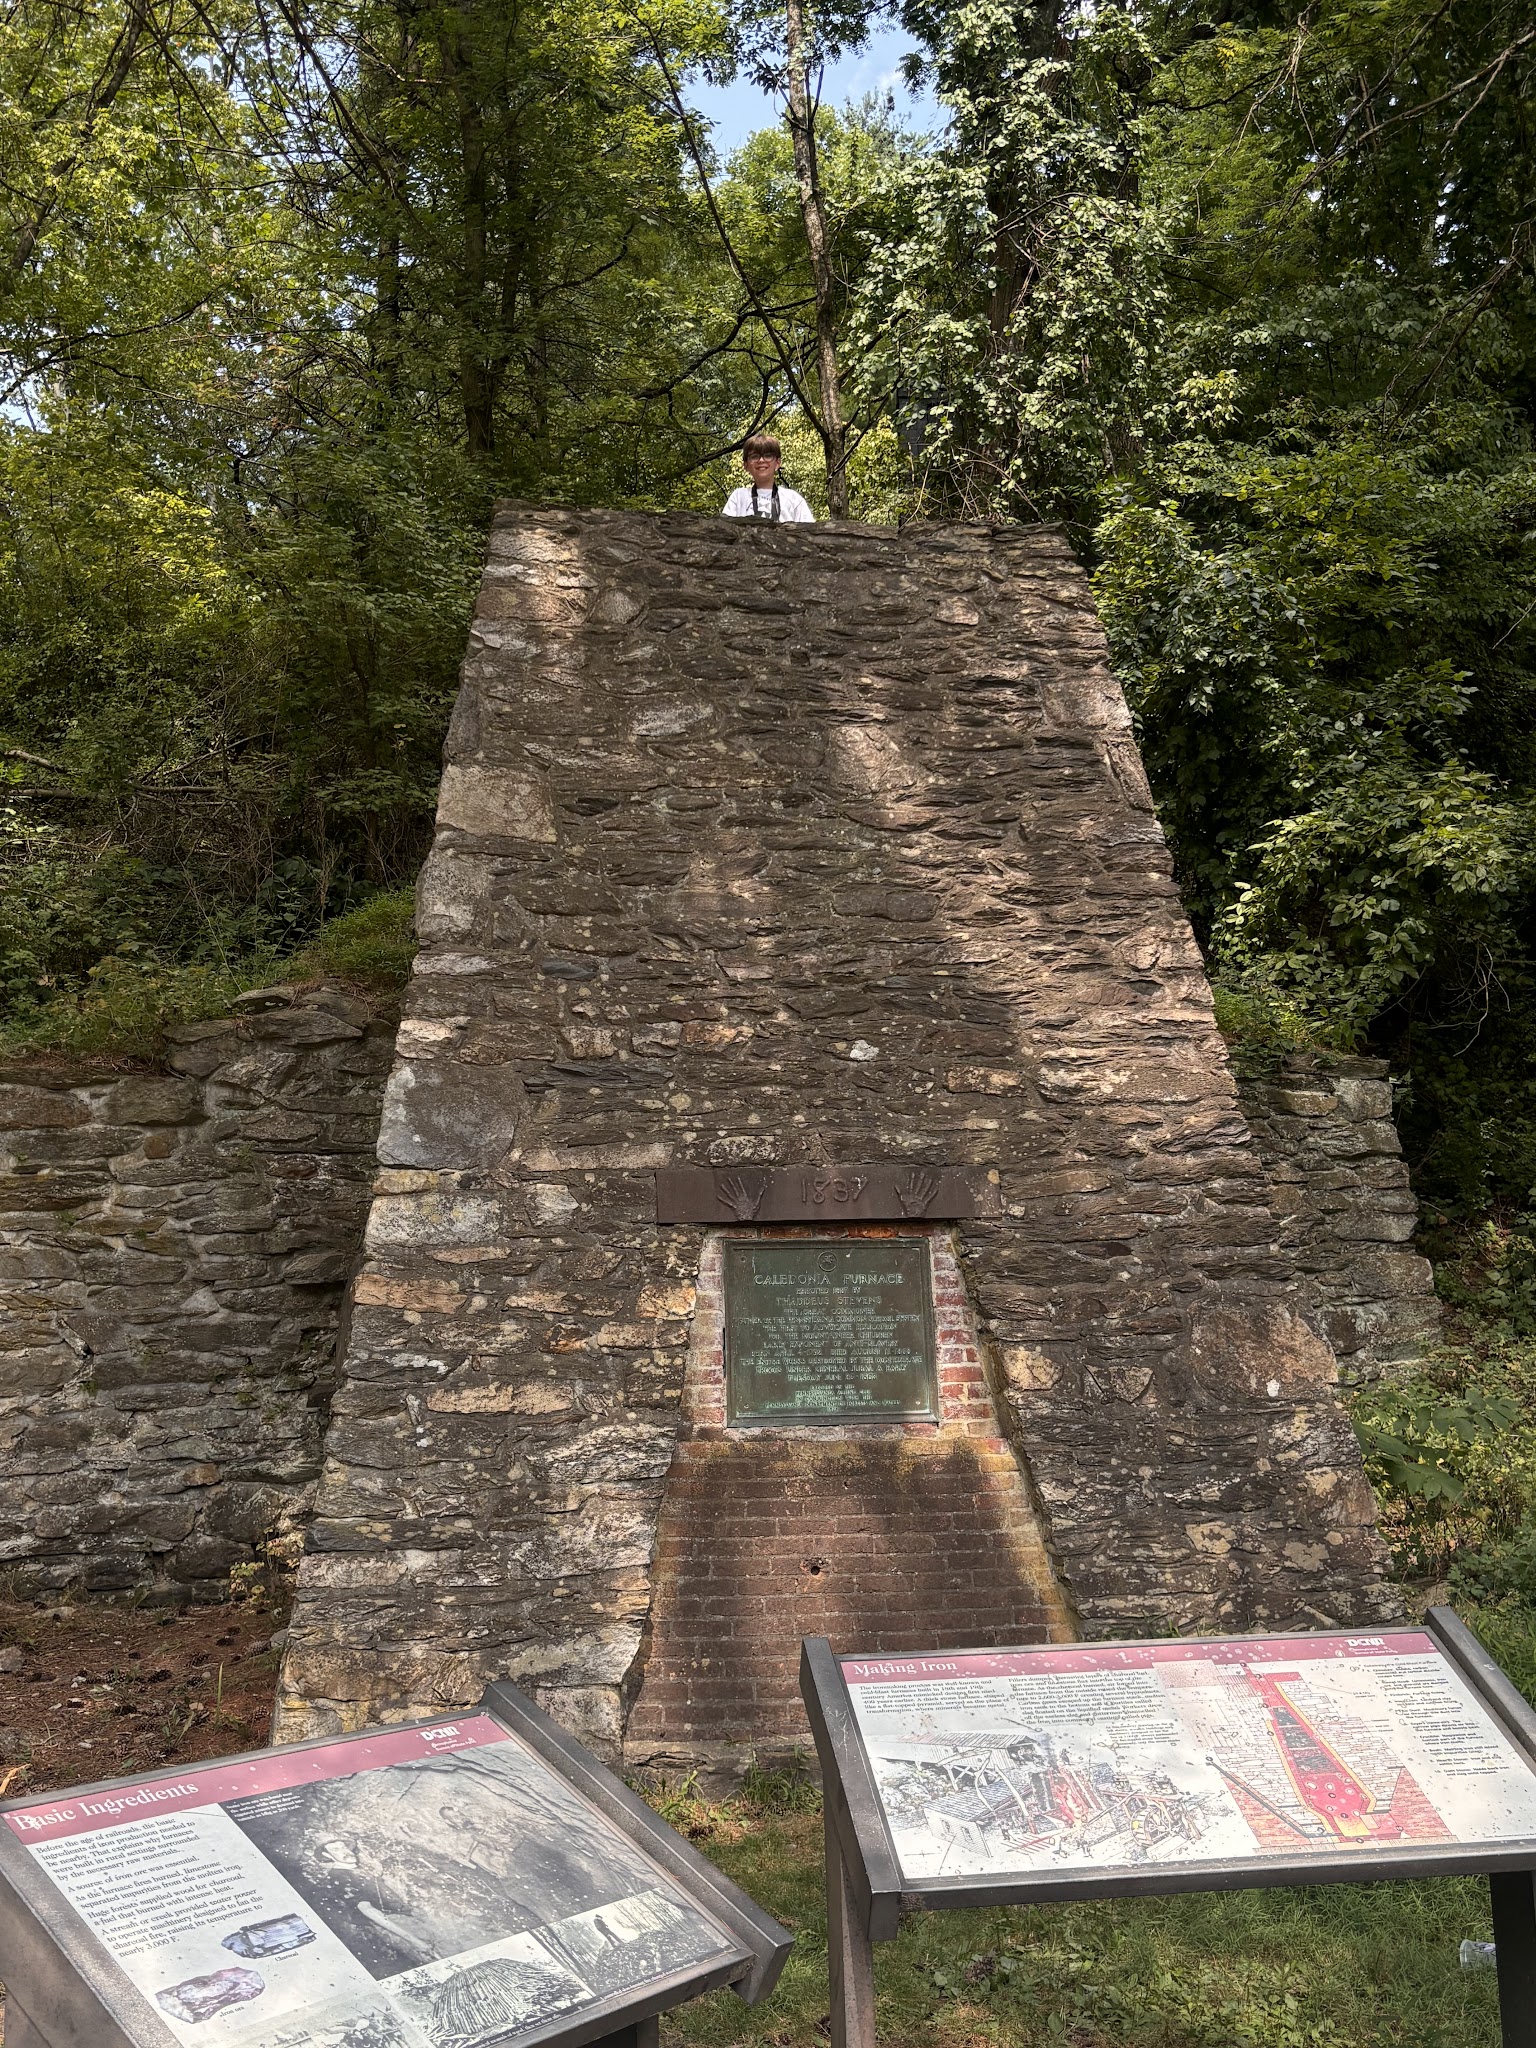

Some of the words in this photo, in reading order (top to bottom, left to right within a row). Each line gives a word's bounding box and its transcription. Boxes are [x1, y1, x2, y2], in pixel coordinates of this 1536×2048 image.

[801, 1178, 869, 1203] 1837
[754, 1273, 831, 1285] CALEDONIA
[843, 1273, 904, 1285] FURNACE
[775, 1297, 830, 1306] THADDEUS
[838, 1296, 883, 1306] STEVENS
[853, 1663, 917, 1675] Making
[920, 1661, 957, 1671] Iron
[13, 1809, 77, 1830] Basic
[78, 1782, 199, 1814] Ingredients
[35, 1844, 63, 1853] Before
[105, 1826, 141, 1838] railroads,
[154, 1818, 175, 1826] basic
[41, 1847, 87, 1863] ingredients
[116, 1830, 158, 1845] production
[159, 1822, 186, 1833] needed
[59, 1854, 89, 1864] nearby.
[89, 1849, 111, 1857] That
[111, 1841, 143, 1853] explains
[161, 1830, 193, 1840] furnaces
[73, 1859, 94, 1868] built
[105, 1852, 126, 1861] rural
[123, 1846, 156, 1856] settings
[157, 1834, 200, 1848] surrounded
[76, 1880, 103, 1890] source
[104, 1875, 113, 1883] of
[86, 1862, 124, 1874] necessary
[86, 1889, 101, 1898] the
[99, 1884, 133, 1894] furnace
[133, 1879, 152, 1887] fires
[151, 1870, 183, 1882] burned,
[183, 1862, 220, 1873] limestone
[80, 1894, 119, 1909] separated
[120, 1885, 161, 1898] impurities
[161, 1880, 181, 1888] from
[182, 1874, 196, 1882] the
[197, 1869, 223, 1879] molten
[87, 1910, 113, 1919] Huge
[110, 1901, 138, 1912] forests
[136, 1892, 172, 1905] supplied
[173, 1886, 195, 1895] wood
[100, 1914, 117, 1925] fuel
[117, 1911, 135, 1919] that
[135, 1902, 165, 1914] burned
[166, 1897, 185, 1906] with
[184, 1891, 213, 1901] intense
[109, 1921, 138, 1932] stream
[150, 1911, 173, 1921] creek
[174, 1901, 208, 1917] provided
[209, 1896, 231, 1905] water
[233, 1889, 256, 1902] power
[118, 1928, 152, 1939] operate
[150, 1915, 192, 1930] machinery
[193, 1905, 226, 1918] designed
[112, 1935, 148, 1949] charcoal
[167, 1922, 195, 1938] raising
[206, 1908, 253, 1923] temperature
[118, 1946, 144, 1957] nearly
